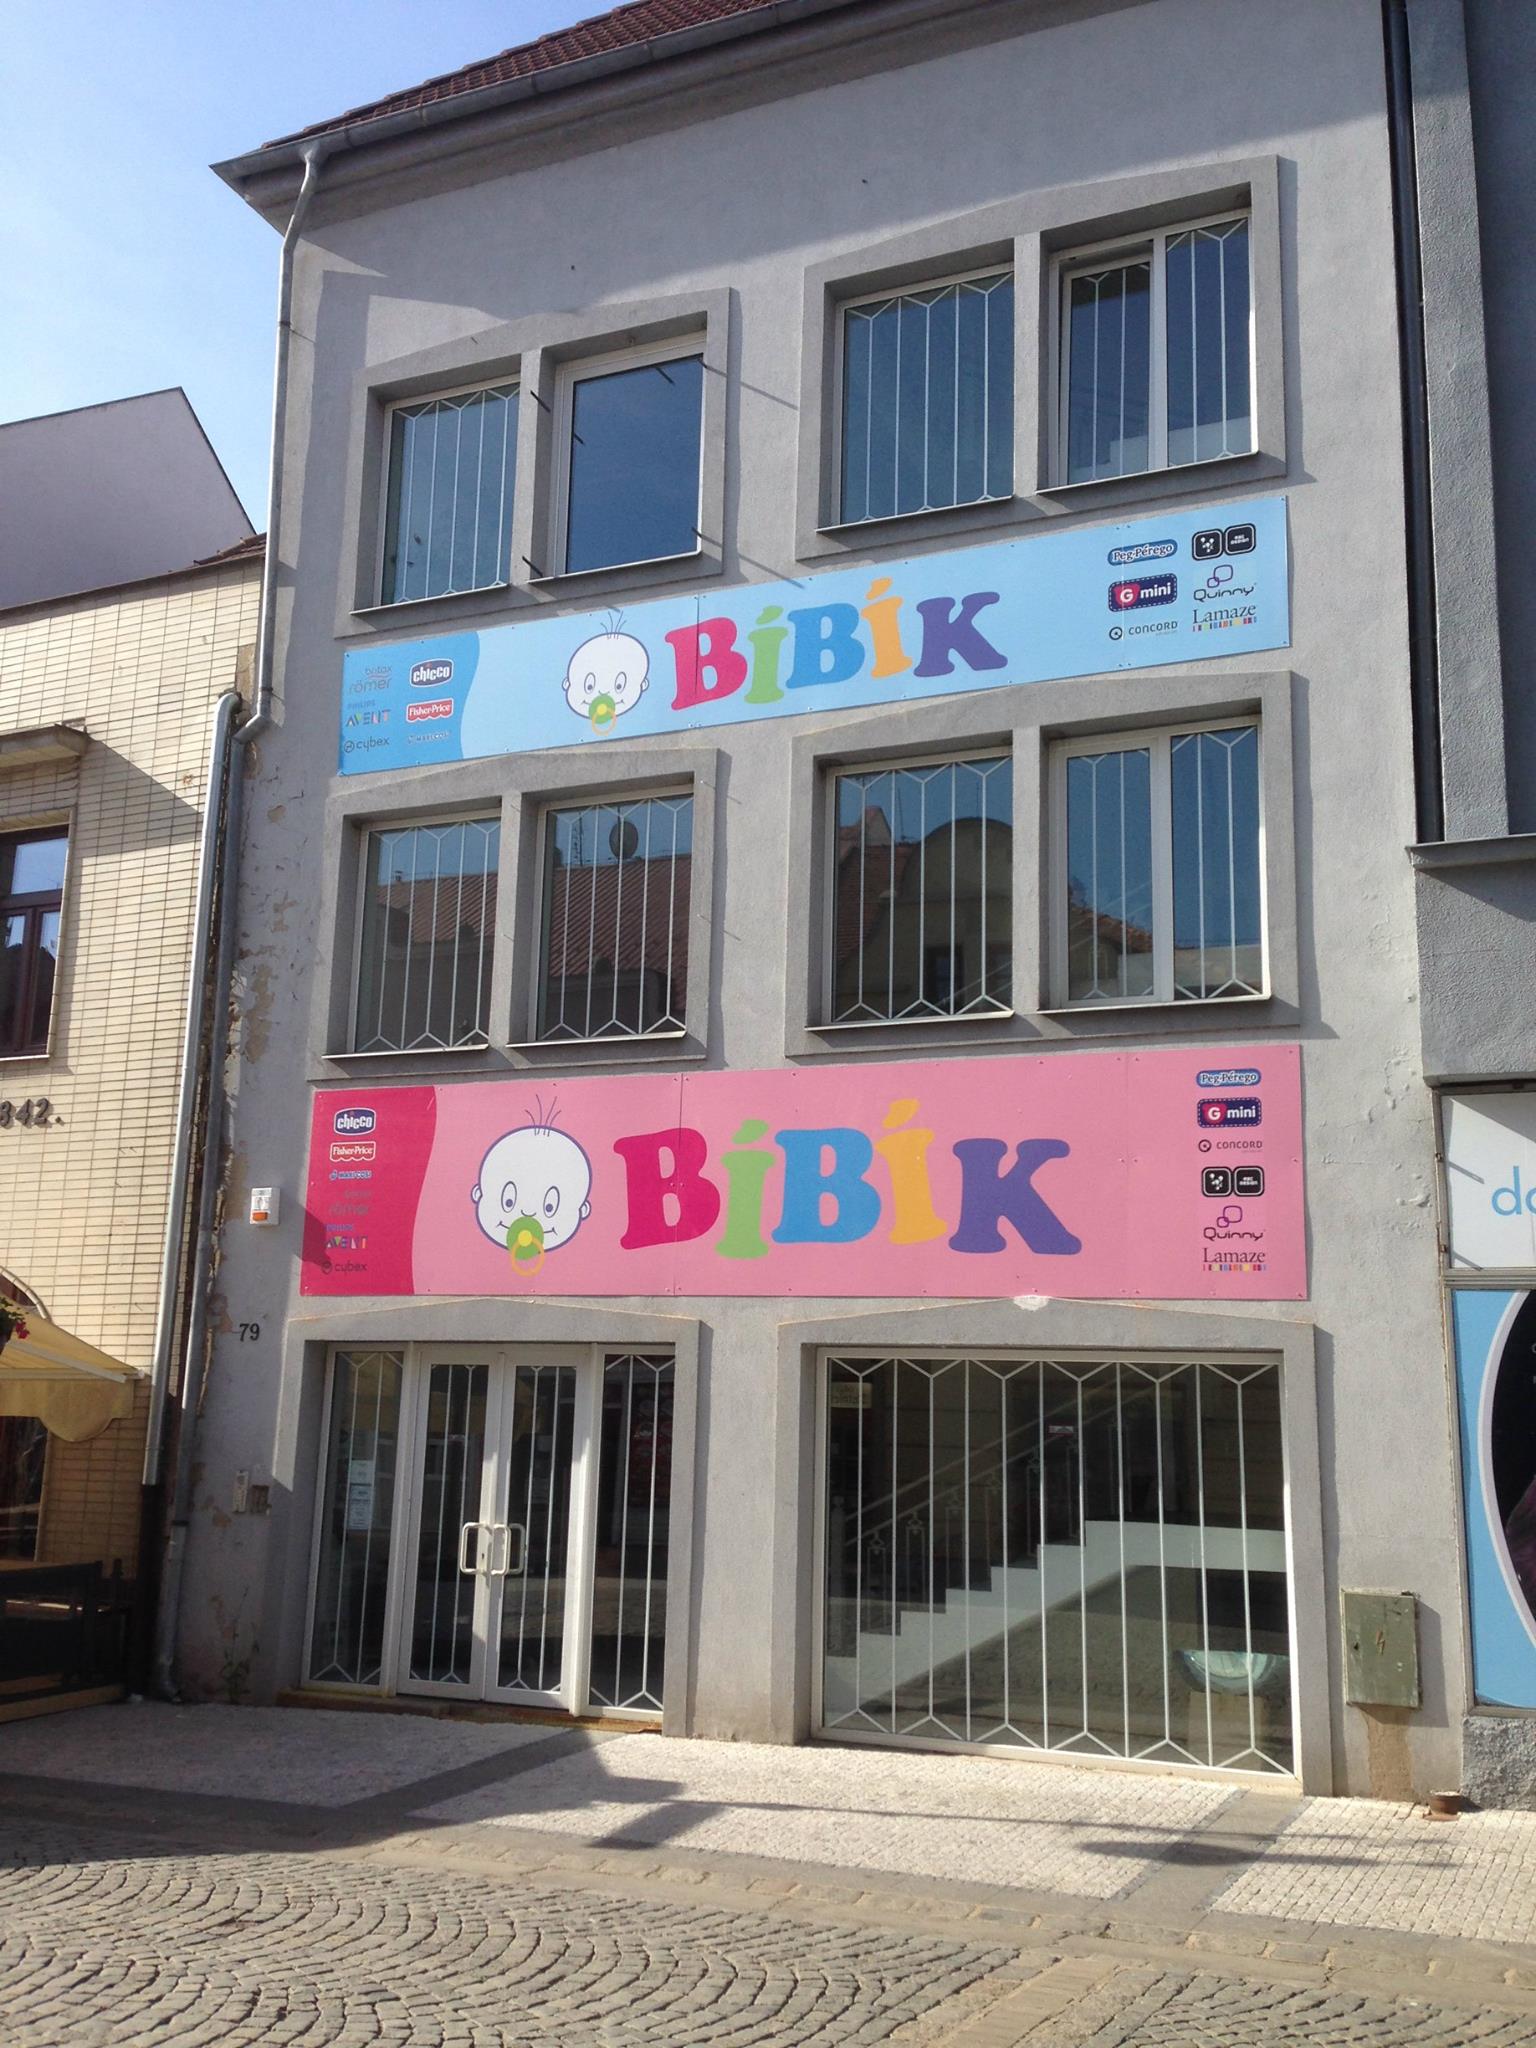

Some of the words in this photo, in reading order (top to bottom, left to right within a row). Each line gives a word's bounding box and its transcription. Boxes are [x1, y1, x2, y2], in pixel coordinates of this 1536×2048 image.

[1120, 588, 1134, 603] G
[1140, 582, 1172, 599] mini
[1193, 586, 1255, 602] Quinny
[1193, 604, 1257, 624] Lamaze
[413, 663, 450, 682] chicco
[409, 703, 451, 717] Fisher-Price
[356, 735, 390, 752] cybex
[336, 1110, 373, 1130] chicco
[1208, 1106, 1222, 1120] G
[1226, 1105, 1257, 1118] mini
[1203, 1226, 1264, 1241] Quinny
[1202, 1247, 1266, 1263] Lamaze
[239, 1322, 260, 1342] 79
